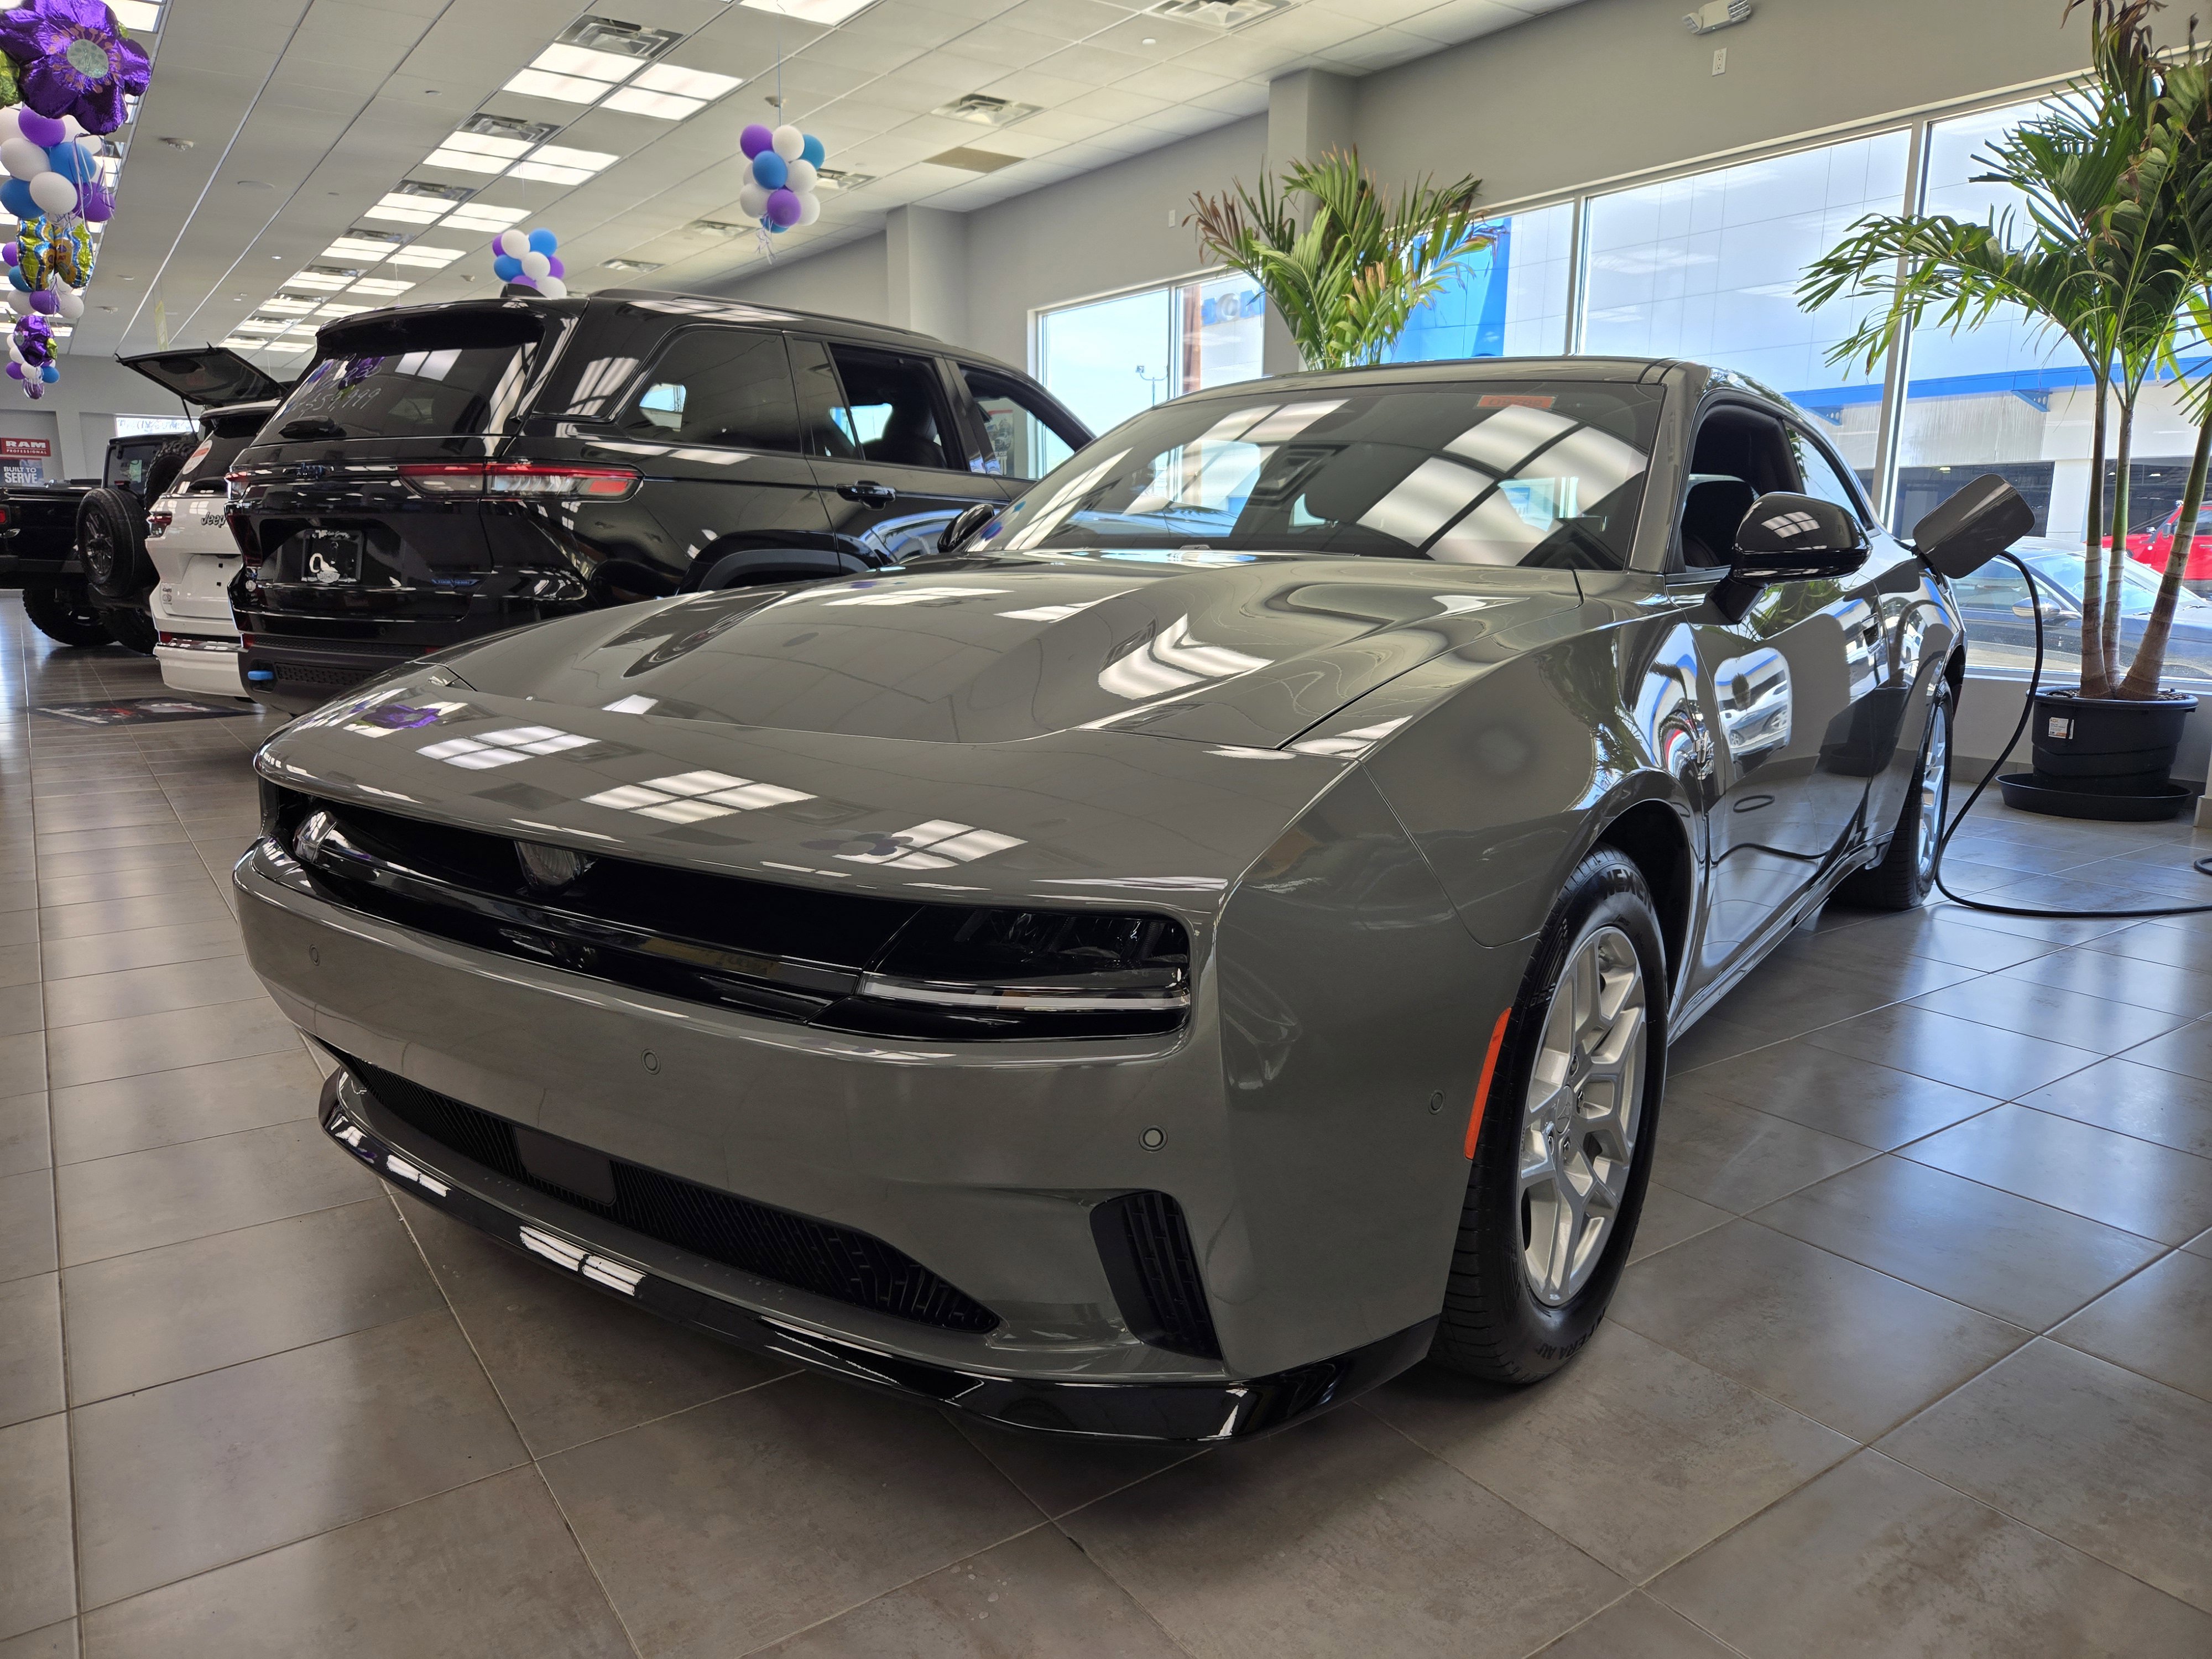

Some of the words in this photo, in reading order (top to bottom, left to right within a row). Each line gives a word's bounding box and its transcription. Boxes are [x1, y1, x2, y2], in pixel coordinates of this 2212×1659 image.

[6, 440, 46, 448] RAM
[4, 472, 38, 484] SERVE
[201, 512, 226, 529] Jeep
